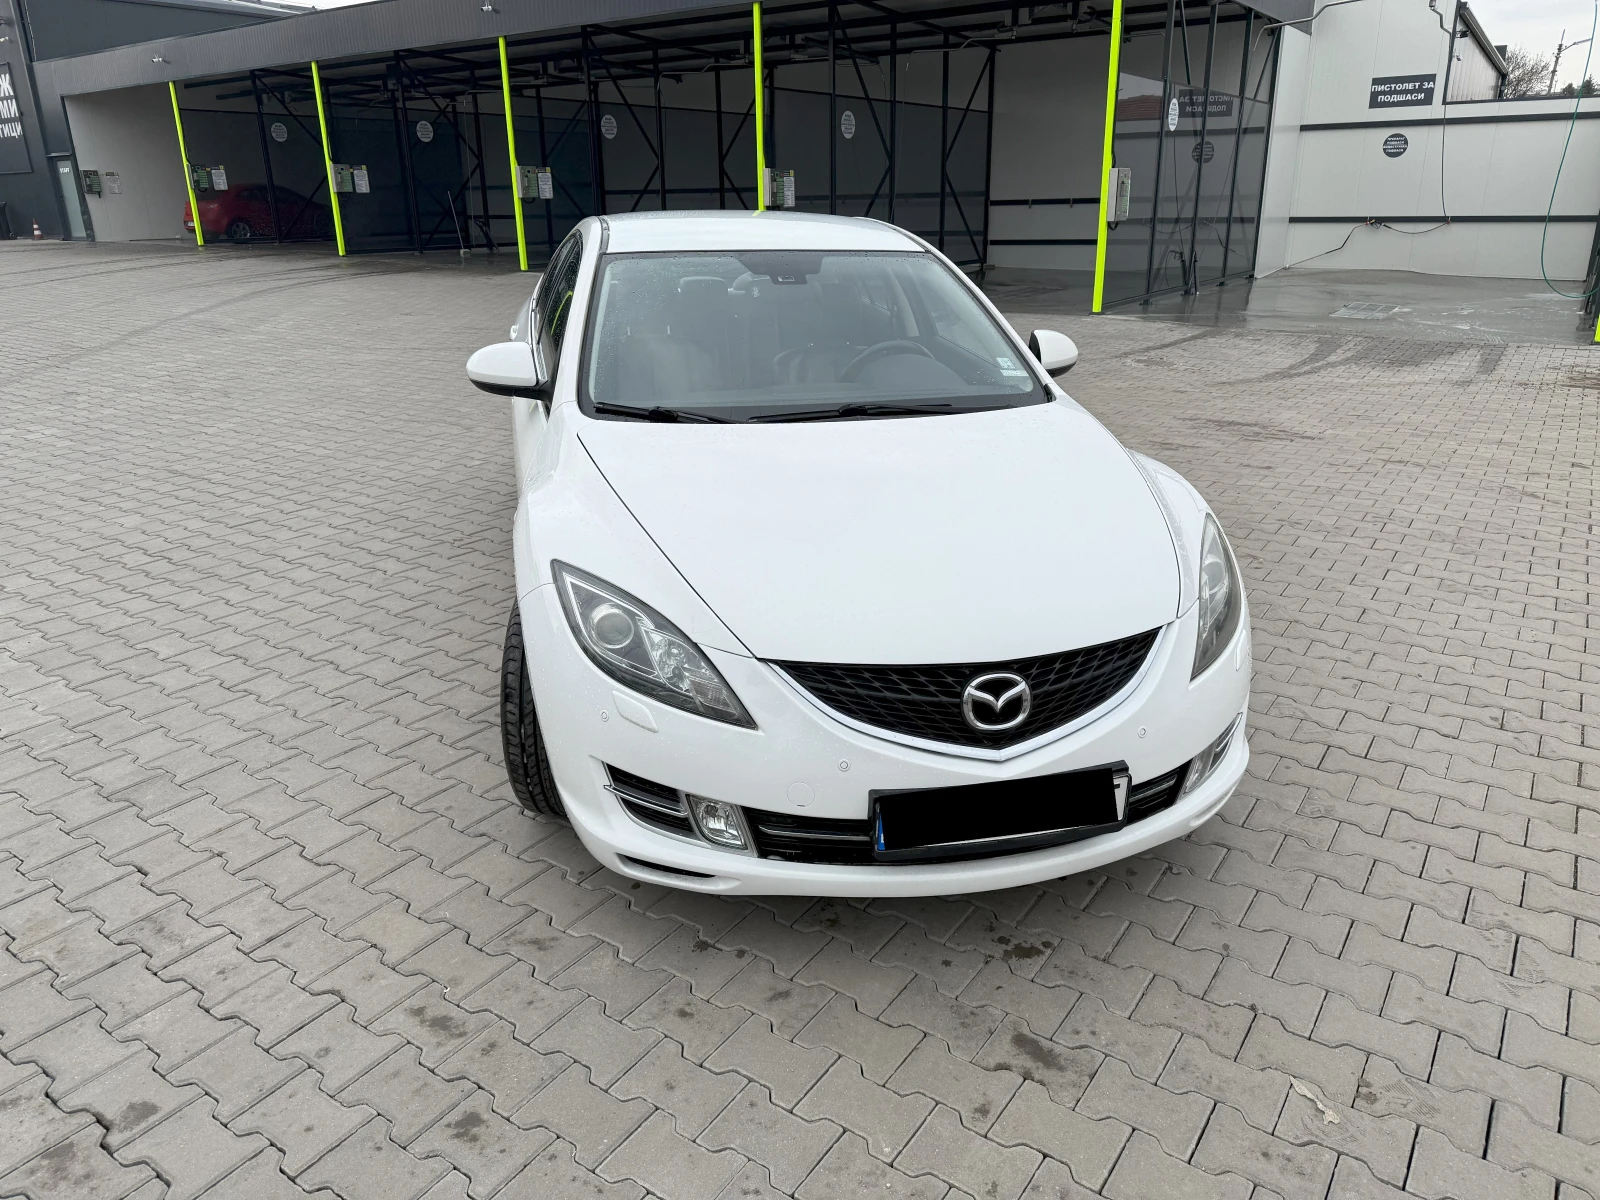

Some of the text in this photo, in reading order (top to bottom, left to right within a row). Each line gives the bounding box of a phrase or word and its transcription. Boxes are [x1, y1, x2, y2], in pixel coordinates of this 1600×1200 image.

[1371, 81, 1435, 92] ПИСТОЛЕТ ЗА
[1377, 92, 1425, 103] ПОДШАСИ
